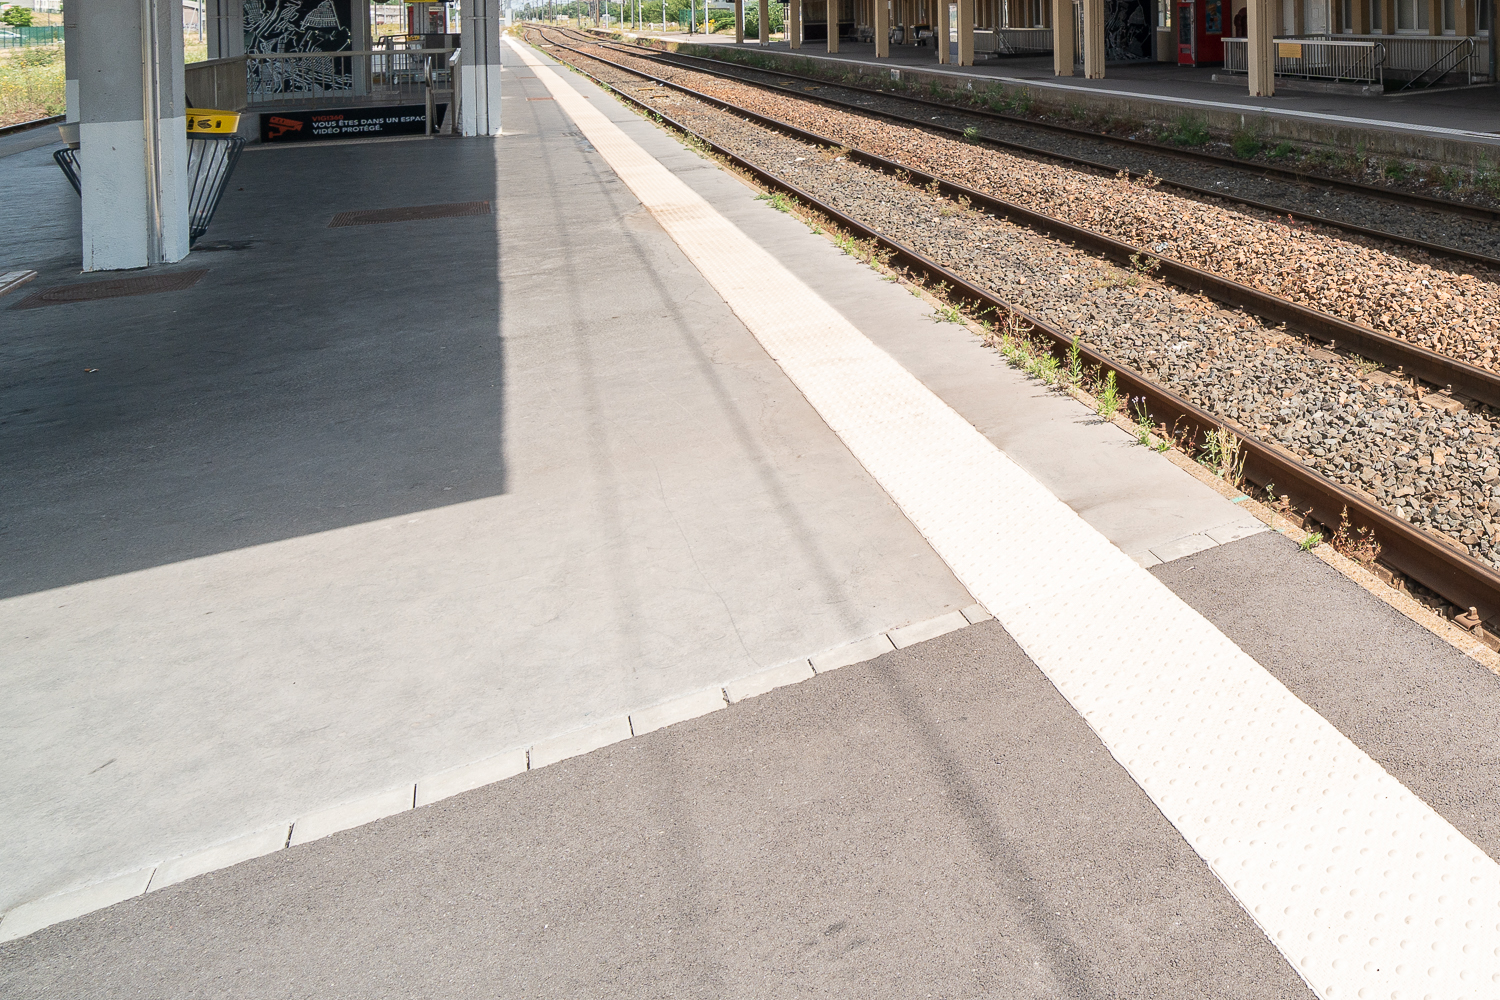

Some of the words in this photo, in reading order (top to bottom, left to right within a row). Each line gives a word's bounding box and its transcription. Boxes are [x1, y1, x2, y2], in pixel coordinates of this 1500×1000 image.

[313, 120, 336, 128] VOUS
[313, 126, 340, 134] VIDÉO
[342, 124, 383, 132] PROTÉGÉ.
